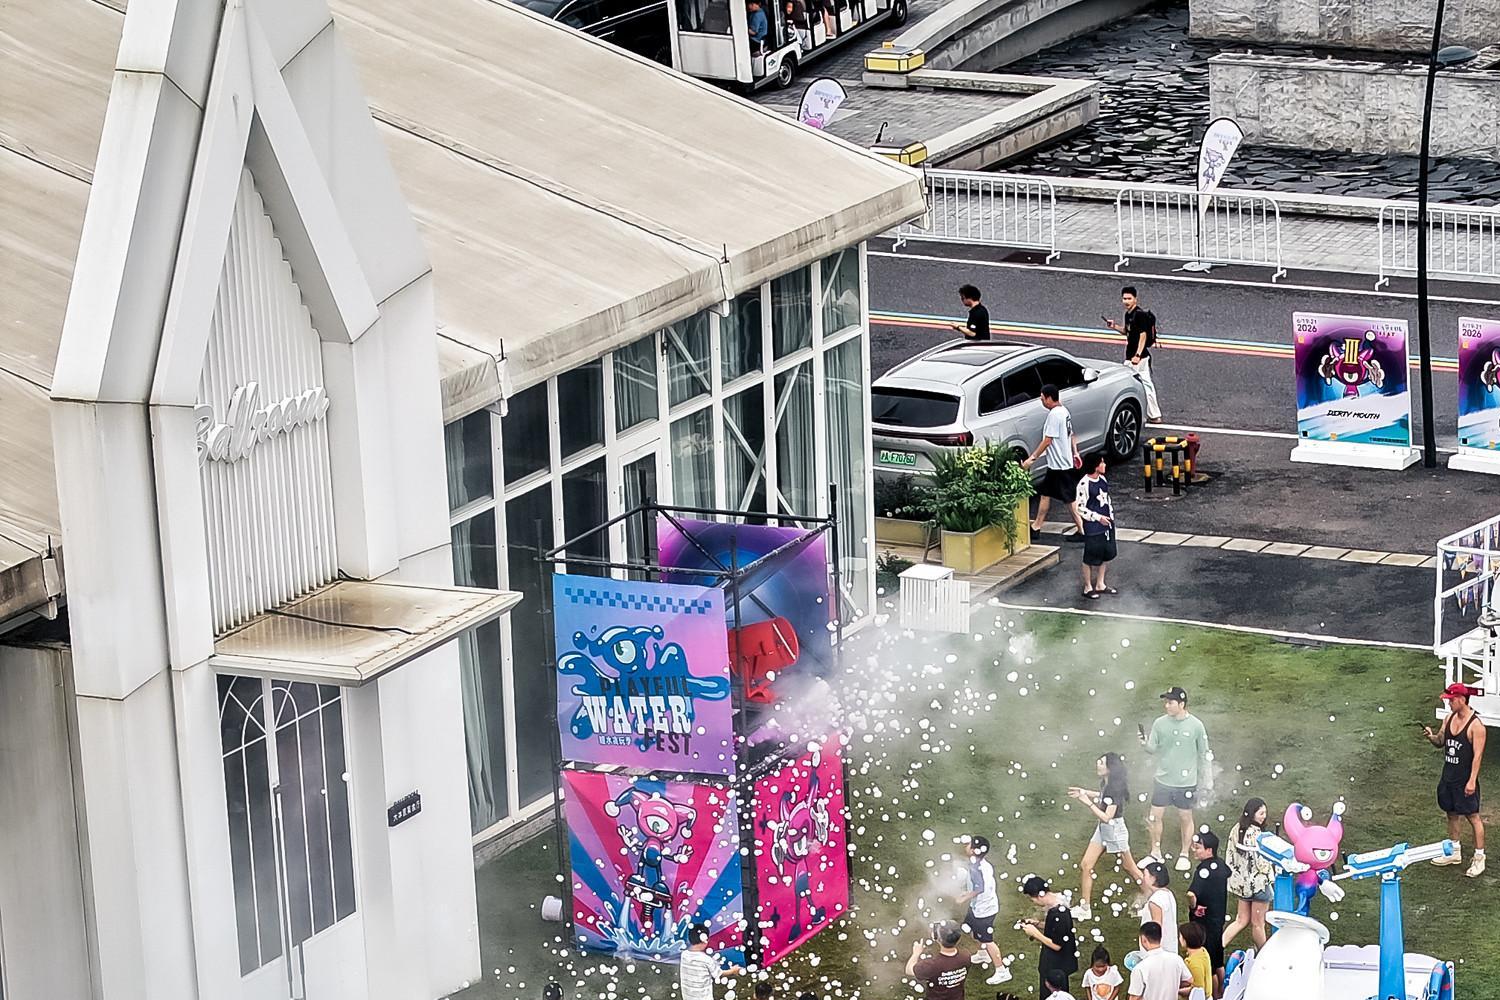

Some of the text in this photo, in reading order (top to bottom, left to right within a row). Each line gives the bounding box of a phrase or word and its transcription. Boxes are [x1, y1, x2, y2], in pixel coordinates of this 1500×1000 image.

[1297, 324, 1318, 333] 2026
[1462, 329, 1482, 338] 2026
[193, 380, 330, 468] Ballroom
[1353, 411, 1380, 420] MOUTH
[602, 675, 692, 698] PLAYFUL
[582, 695, 693, 735] WATER
[644, 727, 693, 756] FEST
